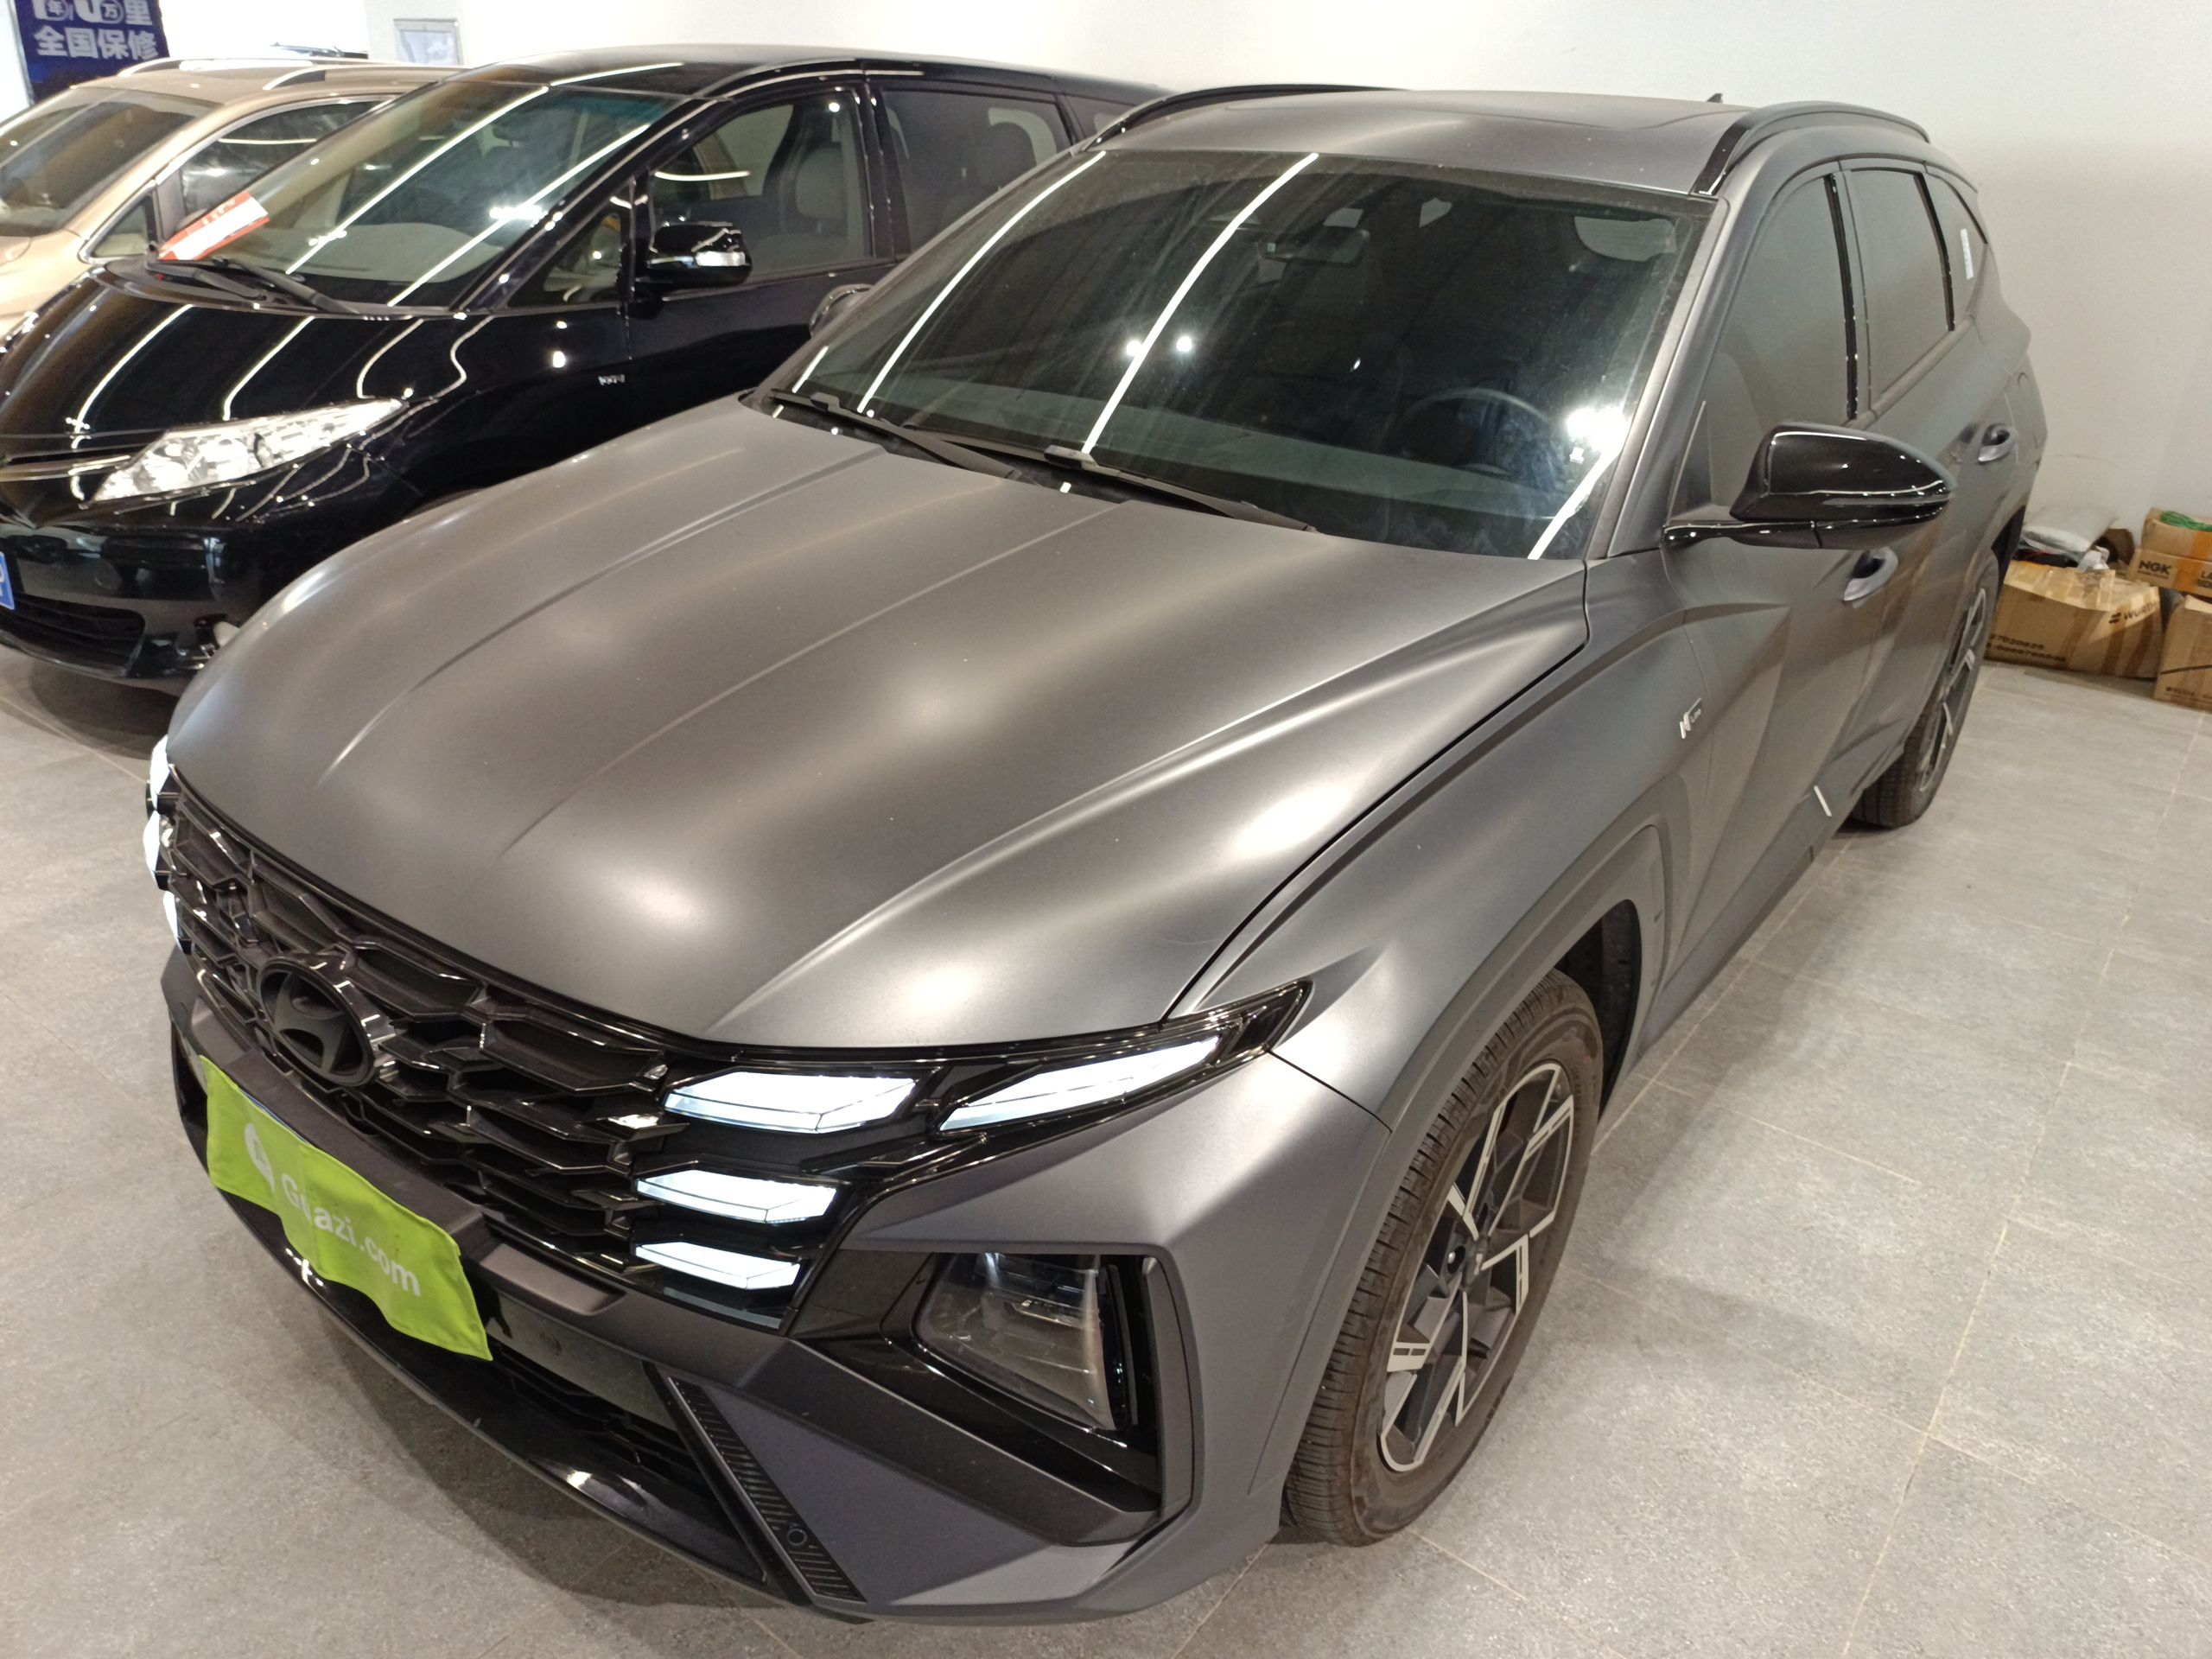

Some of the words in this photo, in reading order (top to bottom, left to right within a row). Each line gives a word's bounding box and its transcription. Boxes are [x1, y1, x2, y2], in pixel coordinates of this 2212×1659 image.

[34, 25, 159, 60] 全国保修
[2139, 560, 2171, 575] NGK
